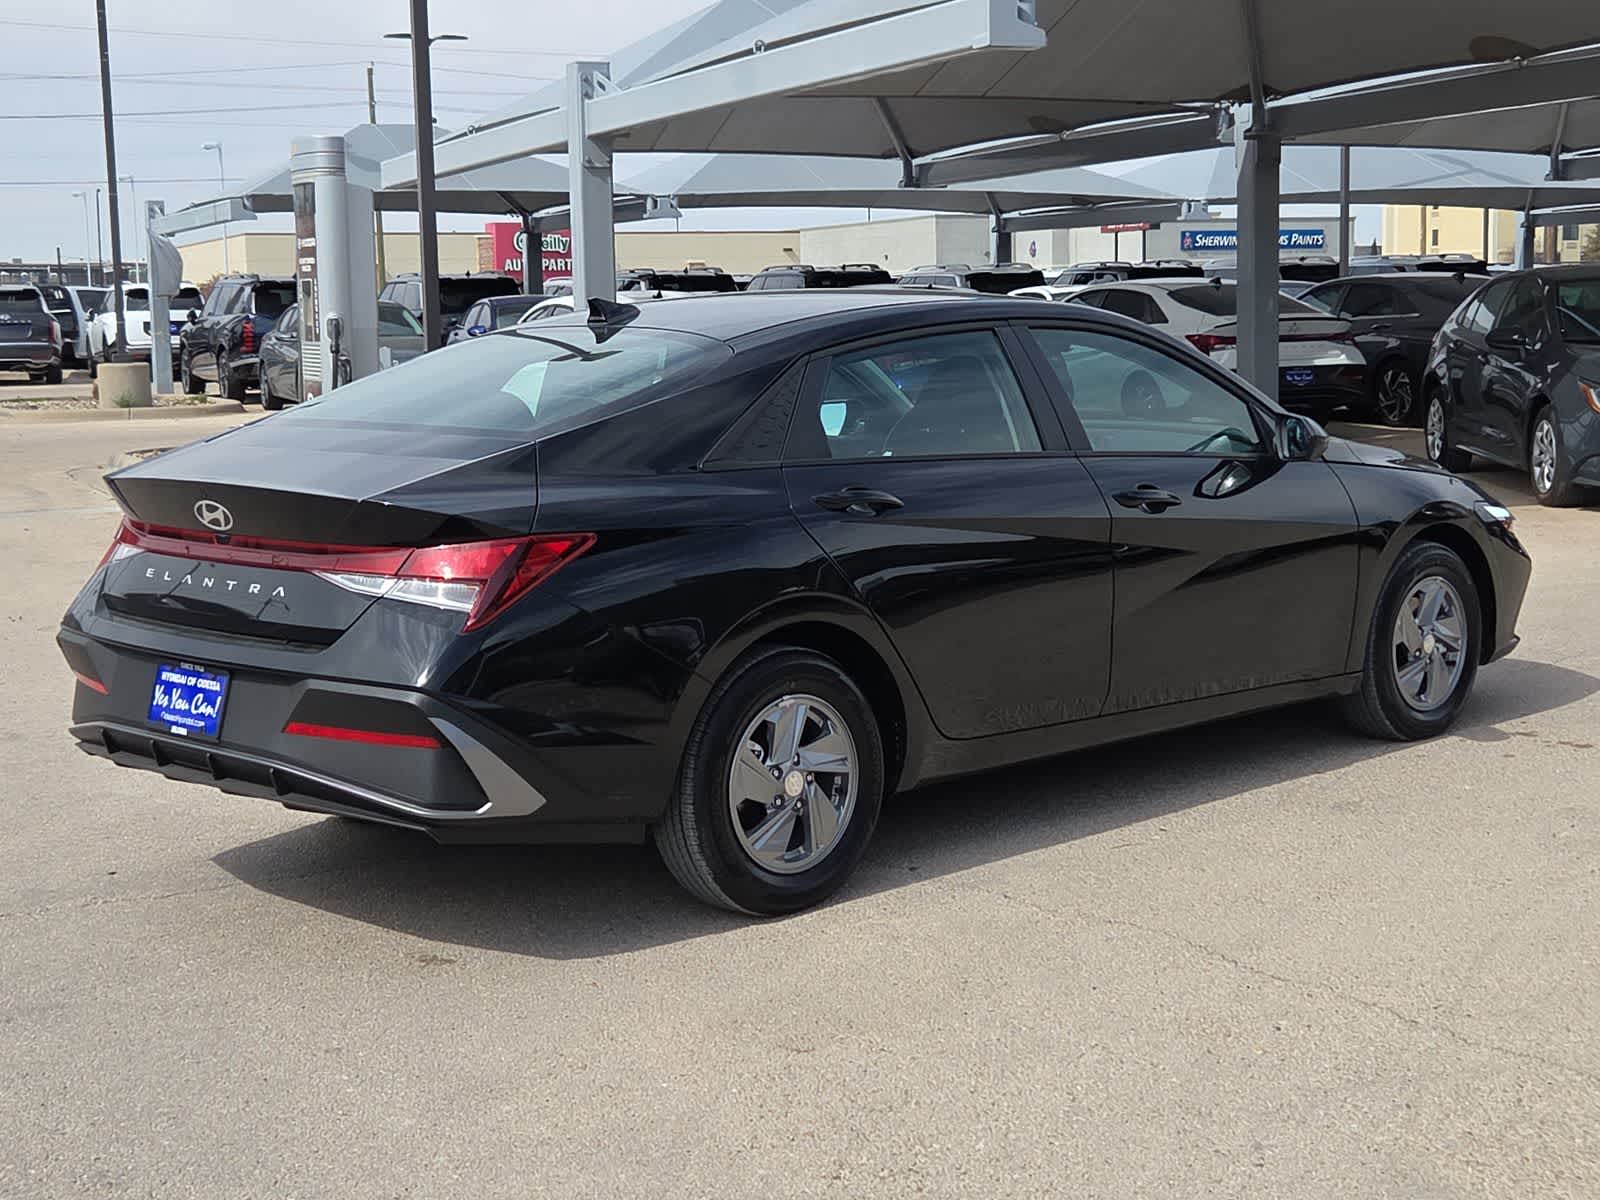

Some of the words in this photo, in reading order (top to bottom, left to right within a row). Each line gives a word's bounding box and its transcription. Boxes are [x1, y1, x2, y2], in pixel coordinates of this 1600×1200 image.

[1290, 233, 1324, 246] PAINTS
[542, 259, 573, 271] PART
[145, 567, 286, 598] ELANTRA
[187, 675, 198, 687] OF
[153, 684, 169, 708] Yes
[170, 687, 190, 710] You
[191, 692, 222, 718] Can!
